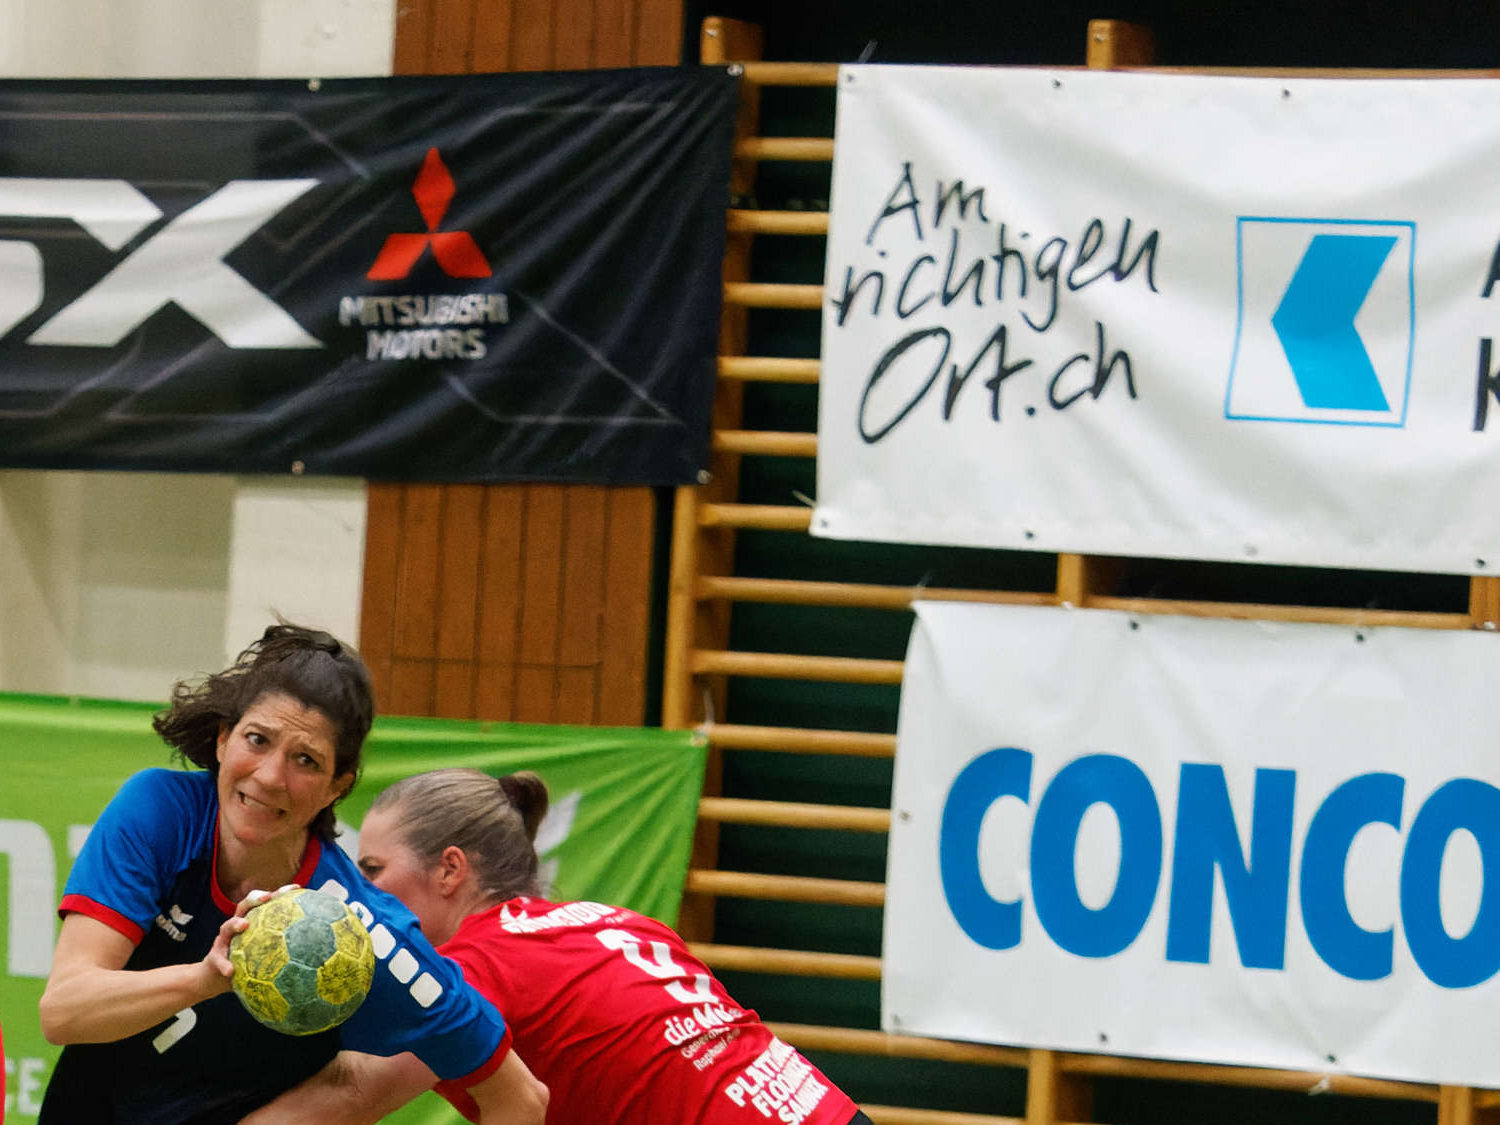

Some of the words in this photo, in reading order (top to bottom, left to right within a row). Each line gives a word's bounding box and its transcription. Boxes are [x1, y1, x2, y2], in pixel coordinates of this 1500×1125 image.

[866, 161, 990, 246] Am
[339, 293, 509, 327] MITSUBISHI
[831, 217, 1162, 332] richtigen
[366, 328, 488, 362] MOTORS
[858, 321, 1138, 444] Ort.ch
[940, 747, 1500, 989] CONCO
[664, 1016, 700, 1046] die
